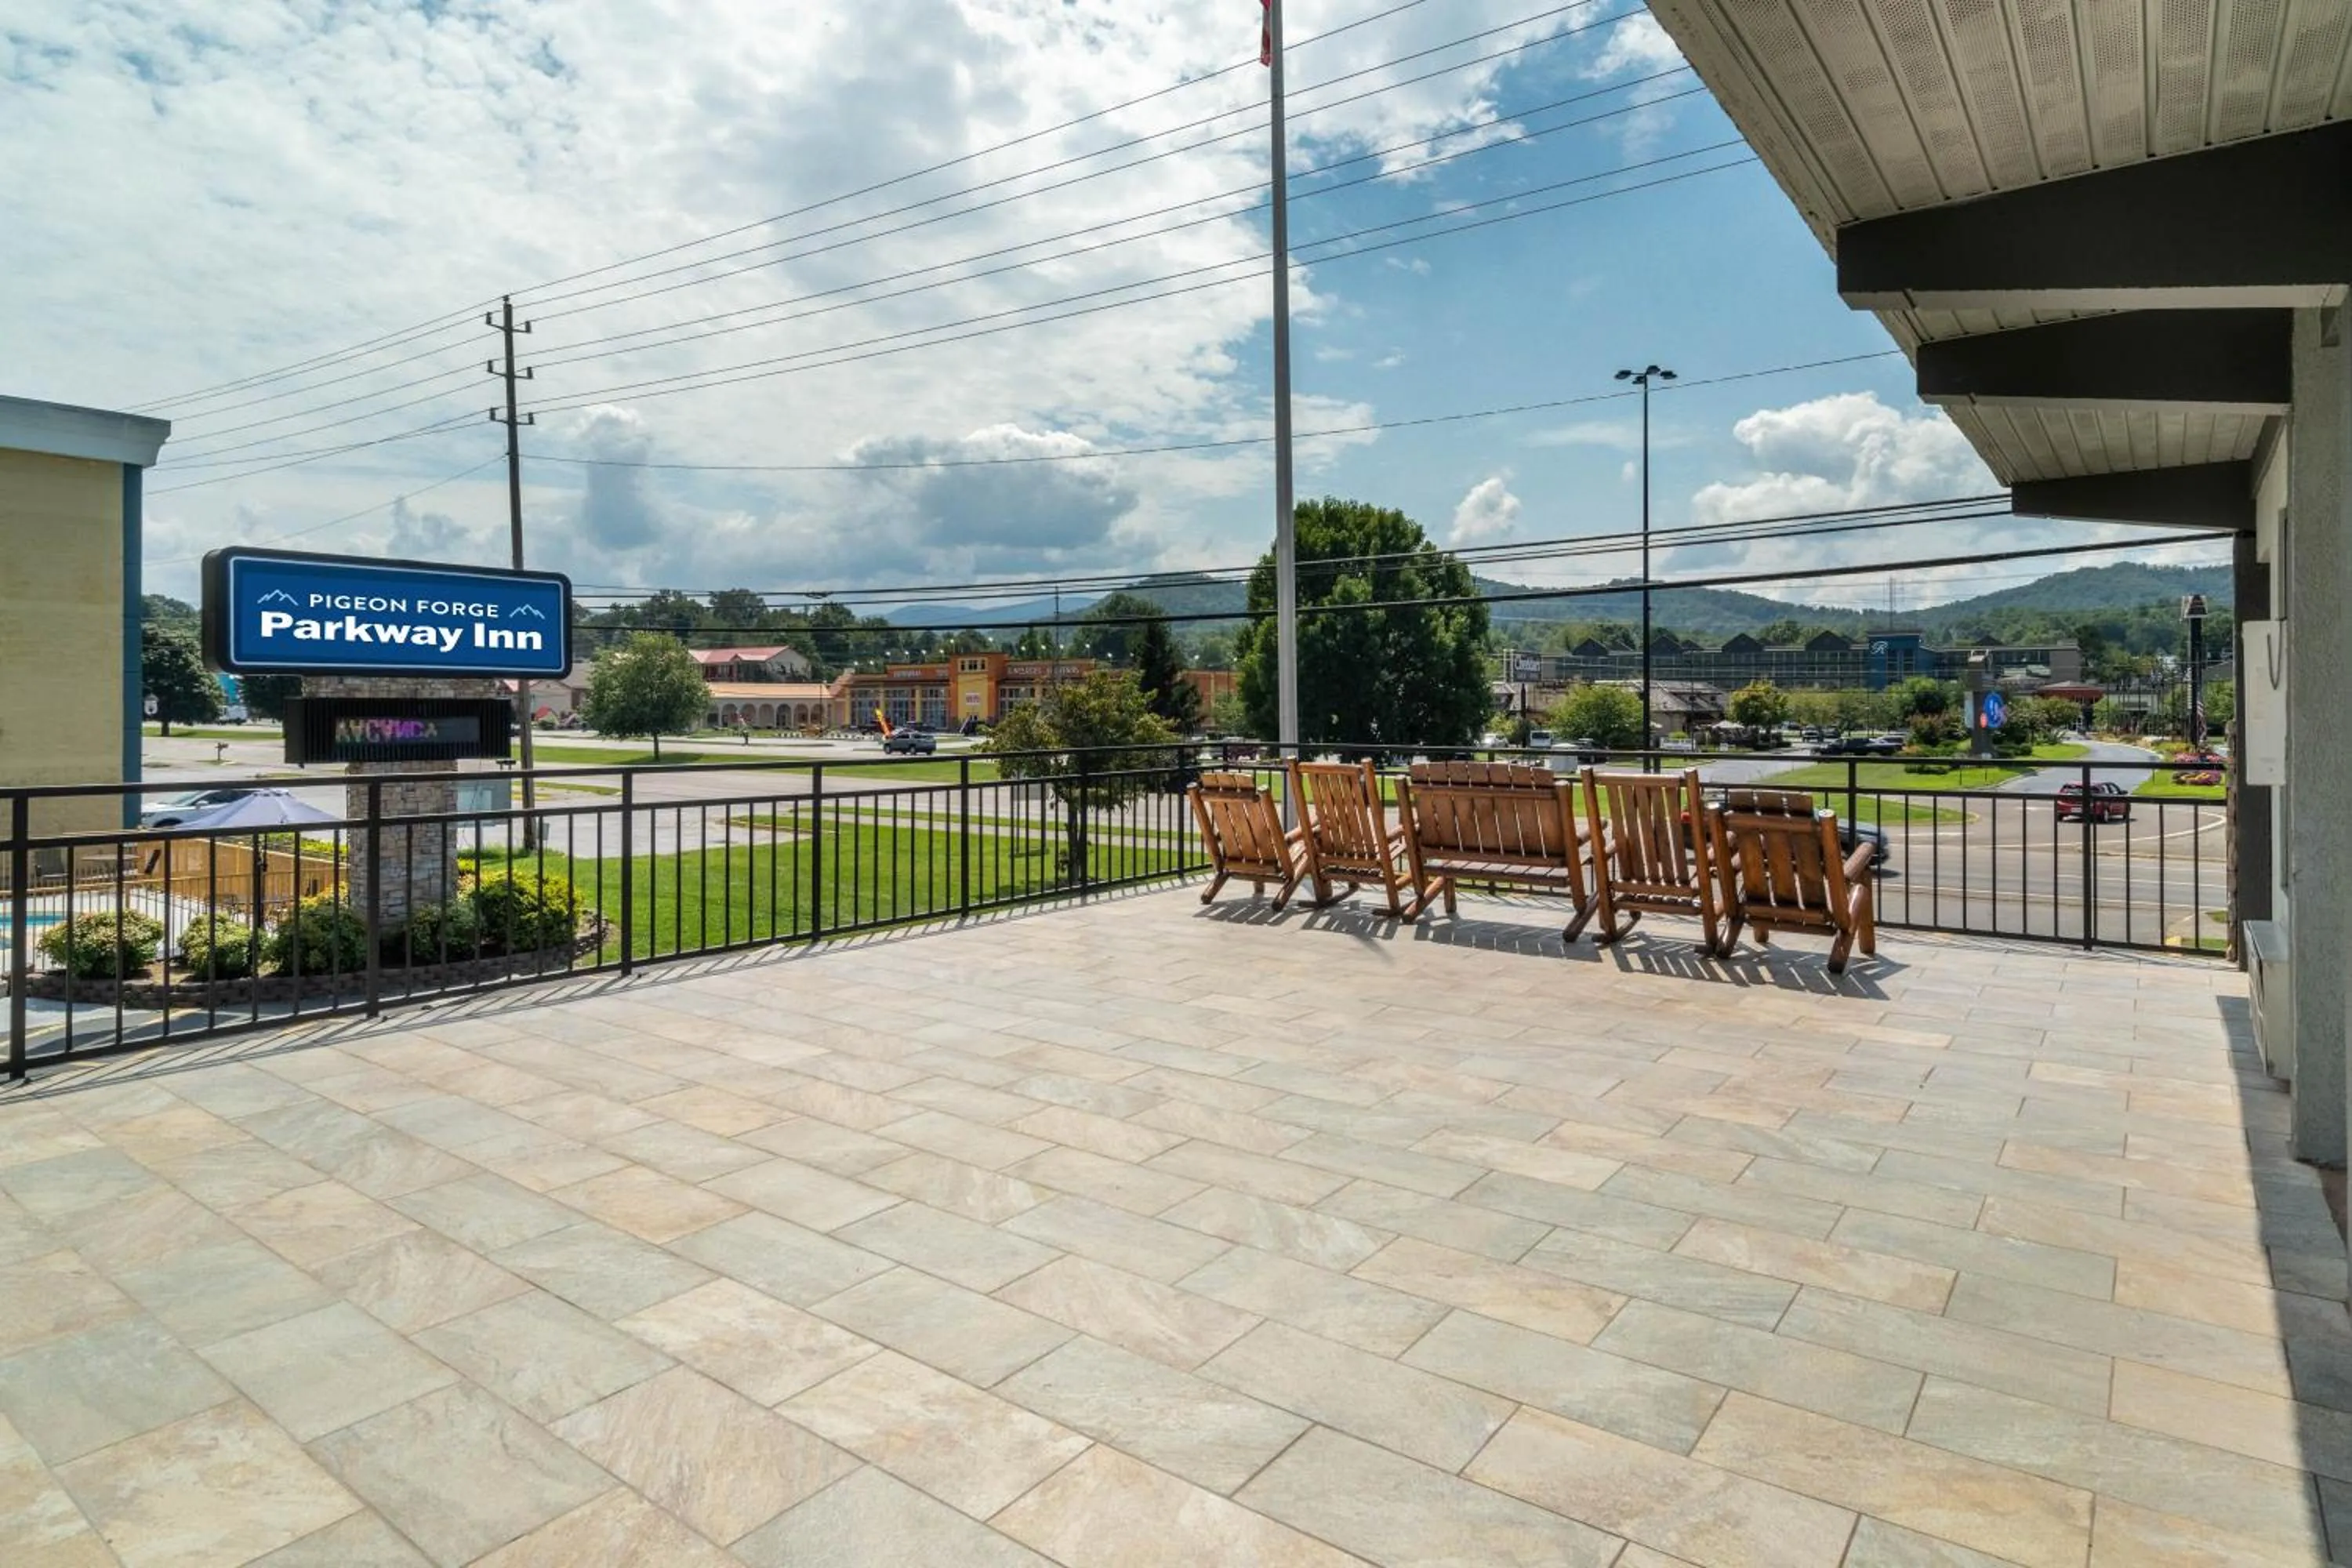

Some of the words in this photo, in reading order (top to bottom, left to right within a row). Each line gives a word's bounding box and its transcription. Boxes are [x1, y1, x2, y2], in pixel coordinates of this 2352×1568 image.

[310, 593, 407, 612] PIGEON
[417, 601, 499, 618] FORGE
[261, 611, 463, 652] Parkway
[474, 622, 543, 650] Inn
